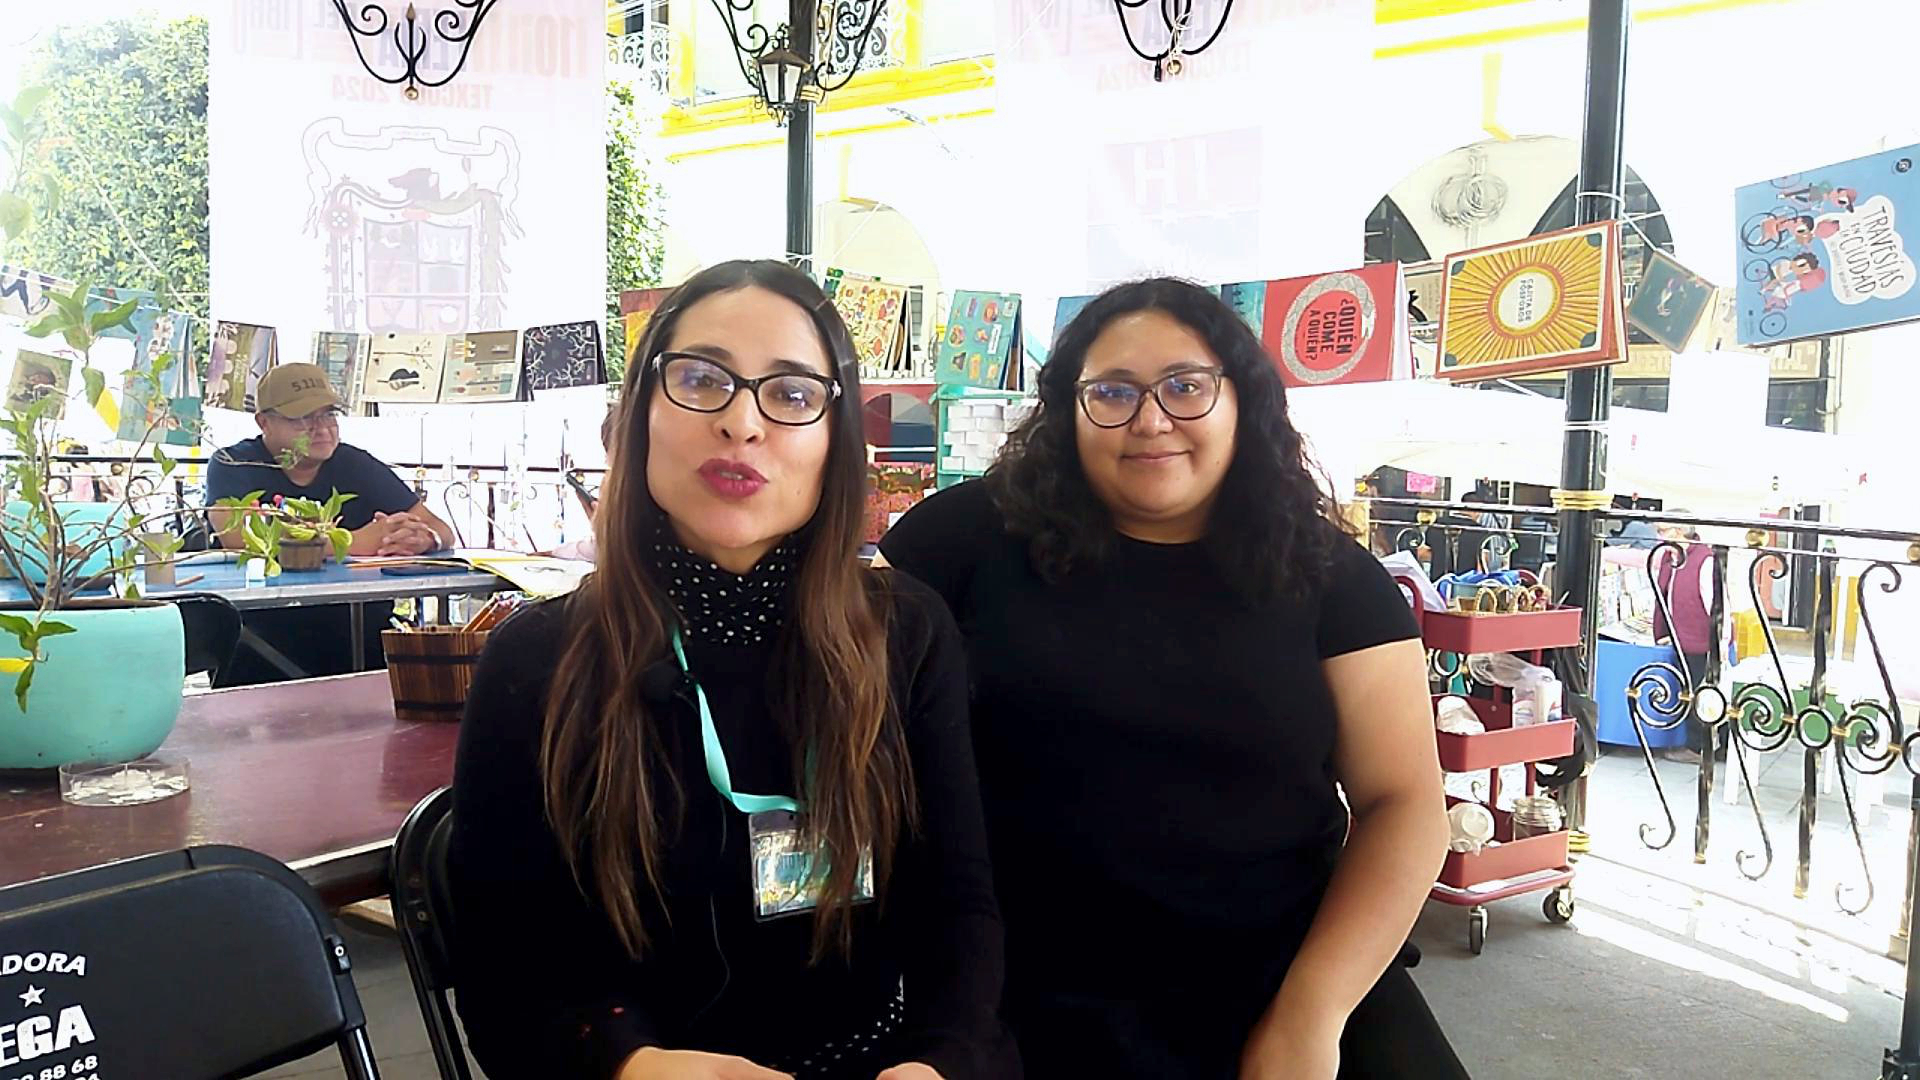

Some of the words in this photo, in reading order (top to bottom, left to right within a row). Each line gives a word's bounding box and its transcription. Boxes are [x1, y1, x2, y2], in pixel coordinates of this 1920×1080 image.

[1863, 205, 1905, 289] TRAVESÍAS
[1526, 278, 1534, 308] CAJITA
[1309, 309, 1320, 318] A
[1336, 299, 1357, 354] ¿QUIÉN
[1525, 310, 1532, 321] DE
[1305, 319, 1321, 361] QUIÉN?
[1320, 311, 1337, 352] COME
[0, 952, 86, 976] DORA
[71, 1055, 98, 1074] 68
